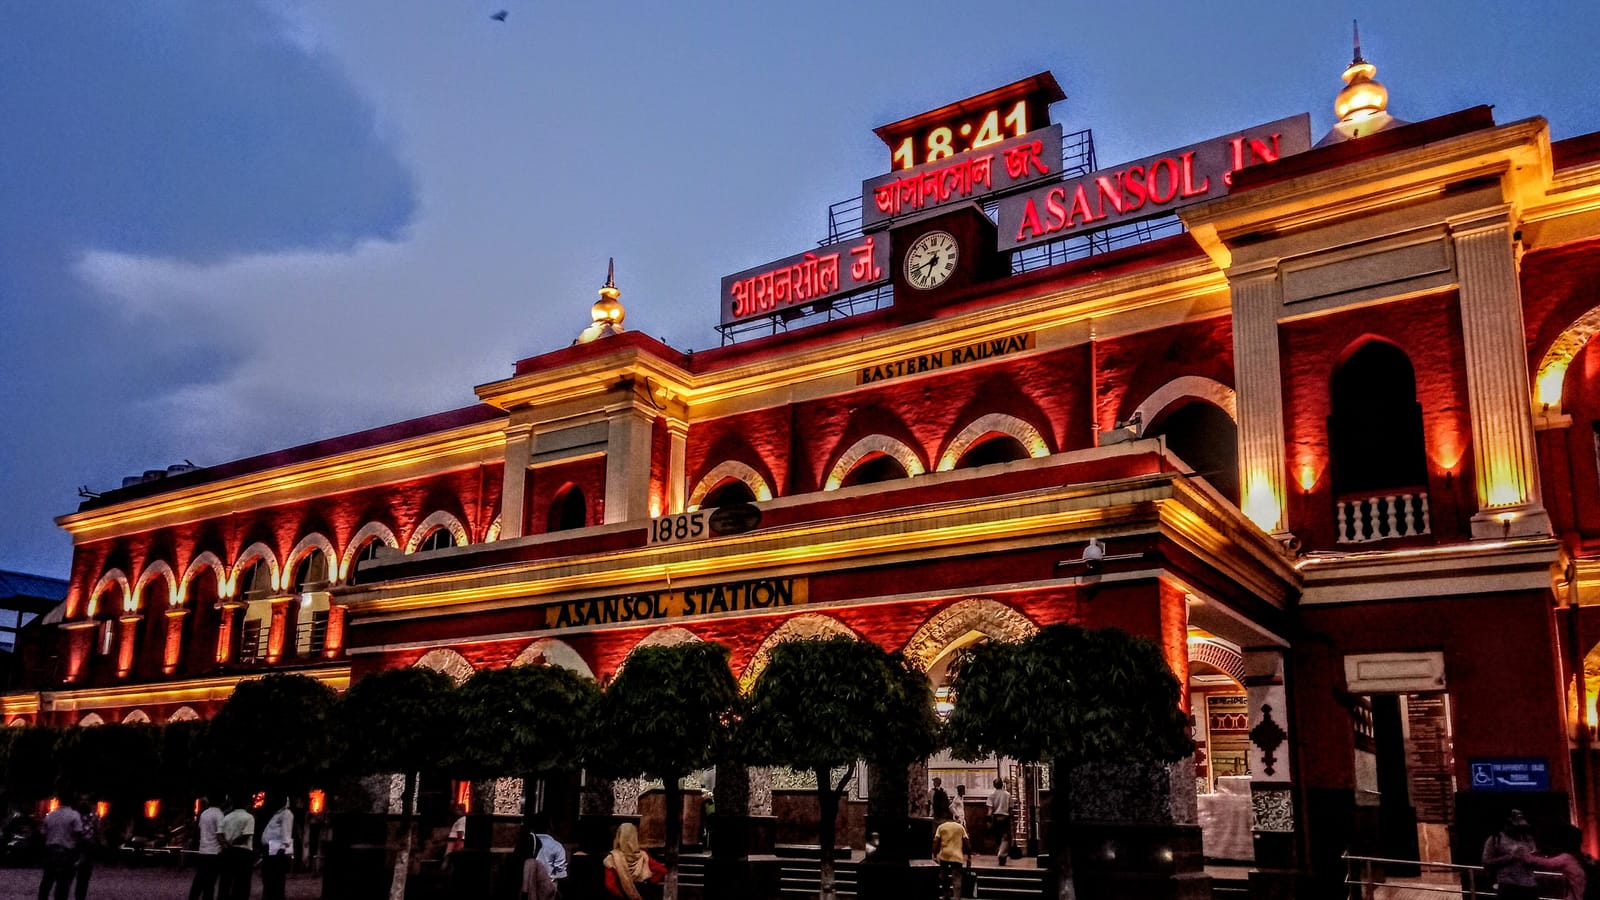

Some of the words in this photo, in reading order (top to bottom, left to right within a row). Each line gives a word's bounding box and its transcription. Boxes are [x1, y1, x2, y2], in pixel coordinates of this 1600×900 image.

[894, 101, 1027, 170] 18:41
[874, 153, 994, 215] আসানসোল
[1004, 140, 1048, 179] জং
[1016, 151, 1209, 242] ASANSOL
[731, 252, 840, 317] आसनसोल
[862, 352, 943, 384] EASTERN
[952, 335, 1029, 365] RAILWAY
[652, 513, 704, 542] 1885
[556, 597, 667, 628] ASANSOL
[683, 580, 793, 616] STATION
